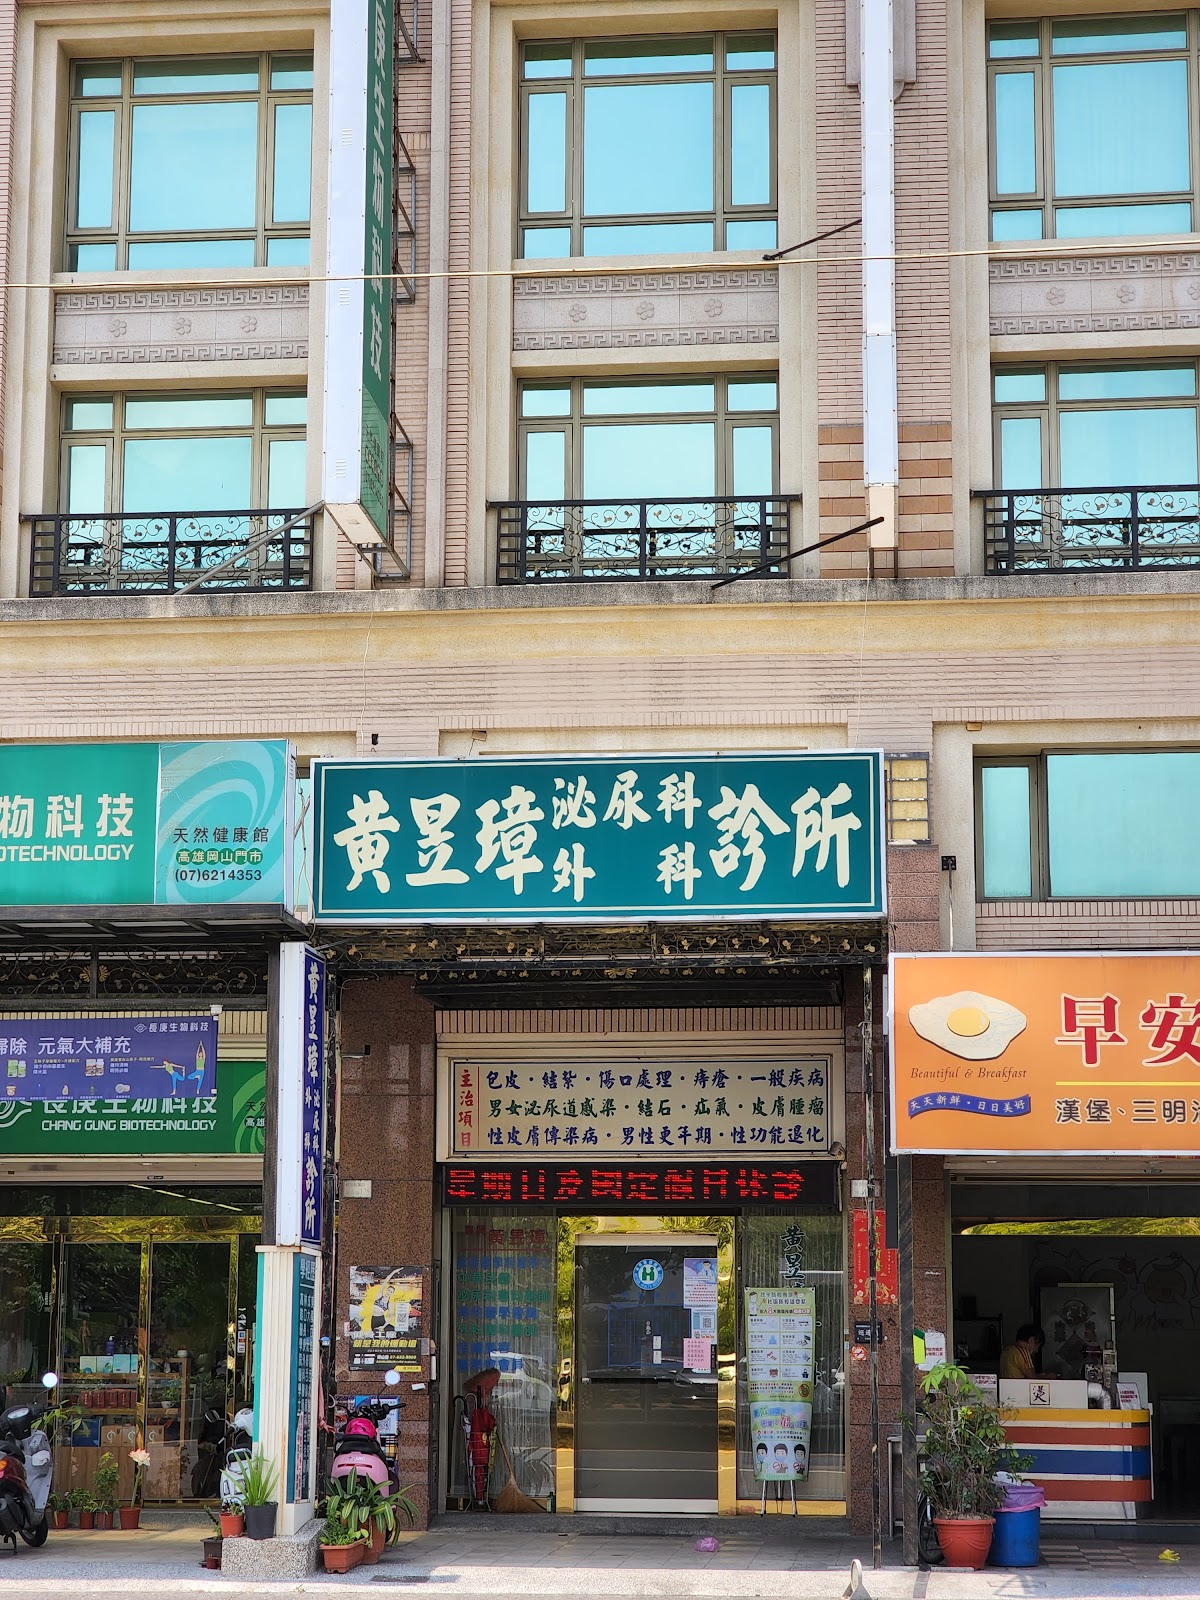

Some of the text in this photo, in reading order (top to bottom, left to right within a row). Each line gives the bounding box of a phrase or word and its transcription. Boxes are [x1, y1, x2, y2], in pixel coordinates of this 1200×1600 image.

[552, 770, 702, 830] 泌尿科
[173, 827, 269, 843] 天然健康館
[333, 785, 544, 896] 黃昱璋
[707, 783, 863, 891] 診所
[177, 849, 263, 863] 高雄岡山門市
[175, 869, 262, 882] (07)6214353
[149, 1022, 209, 1033] 長庚生物科技
[307, 962, 321, 1084] 黃昱璋
[38, 1036, 131, 1055] 元氣大補充
[910, 1067, 1027, 1082] Beautiful & Breakfast
[458, 1069, 474, 1148] 主治項目
[42, 1120, 217, 1131] CHANG GUNG BIOTECHNOLOGY
[304, 1156, 319, 1238] 診所
[780, 1225, 806, 1287] 黃昱
[1032, 1385, 1047, 1402] 燙
